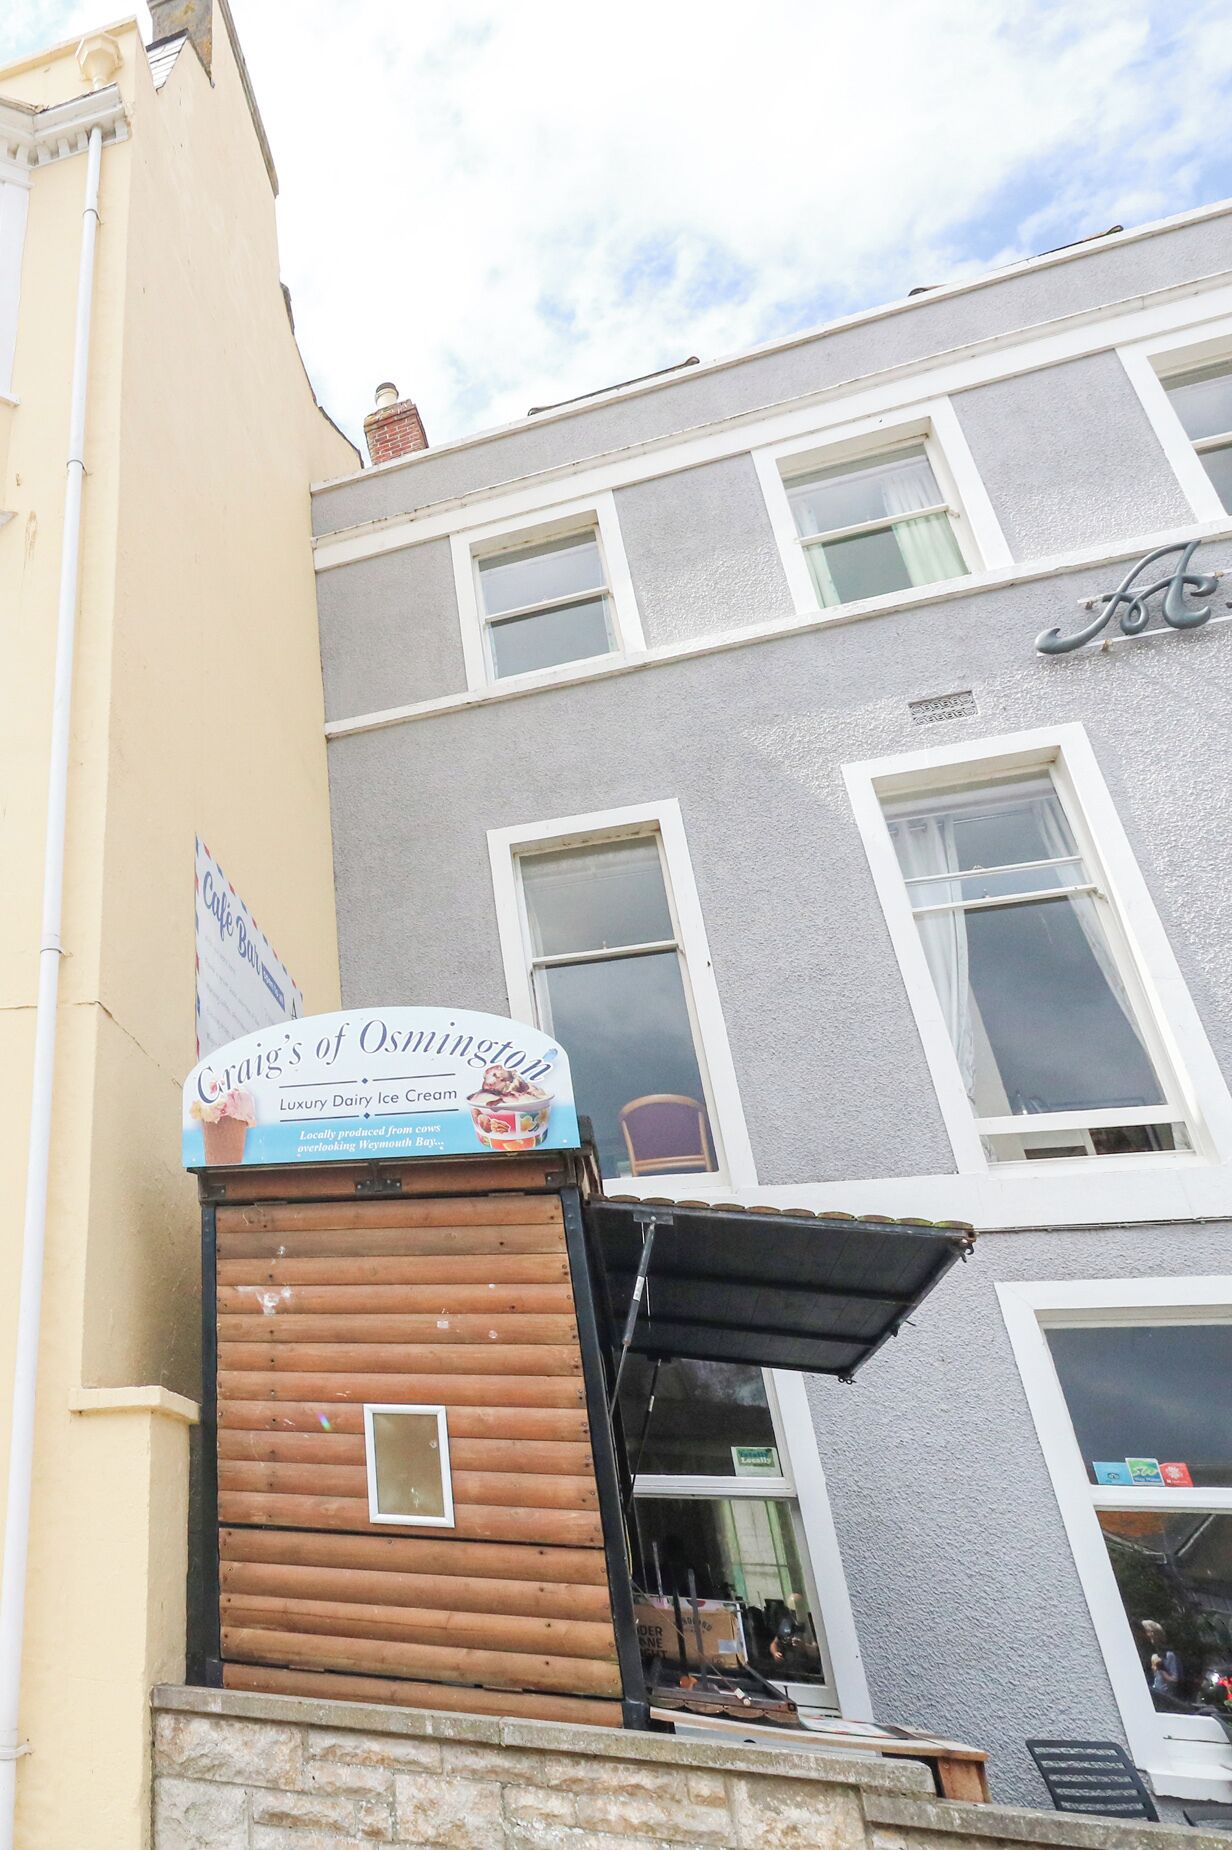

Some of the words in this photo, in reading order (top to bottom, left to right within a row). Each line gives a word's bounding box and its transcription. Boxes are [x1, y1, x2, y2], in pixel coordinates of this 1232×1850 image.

[202, 870, 234, 942] Café
[236, 915, 261, 976] Bar
[197, 1033, 303, 1104] Craig's
[316, 1022, 350, 1065] of
[359, 1019, 552, 1082] Osmington
[280, 1096, 327, 1111] Luxury
[333, 1093, 373, 1108] Dairy
[378, 1091, 399, 1104] Ice
[405, 1089, 457, 1102] Cream
[299, 1129, 337, 1142] Locally
[337, 1127, 385, 1140] produced
[385, 1124, 413, 1137] from
[415, 1124, 441, 1134] cows
[297, 1141, 356, 1153] overlooking
[358, 1137, 412, 1150] Weymouth
